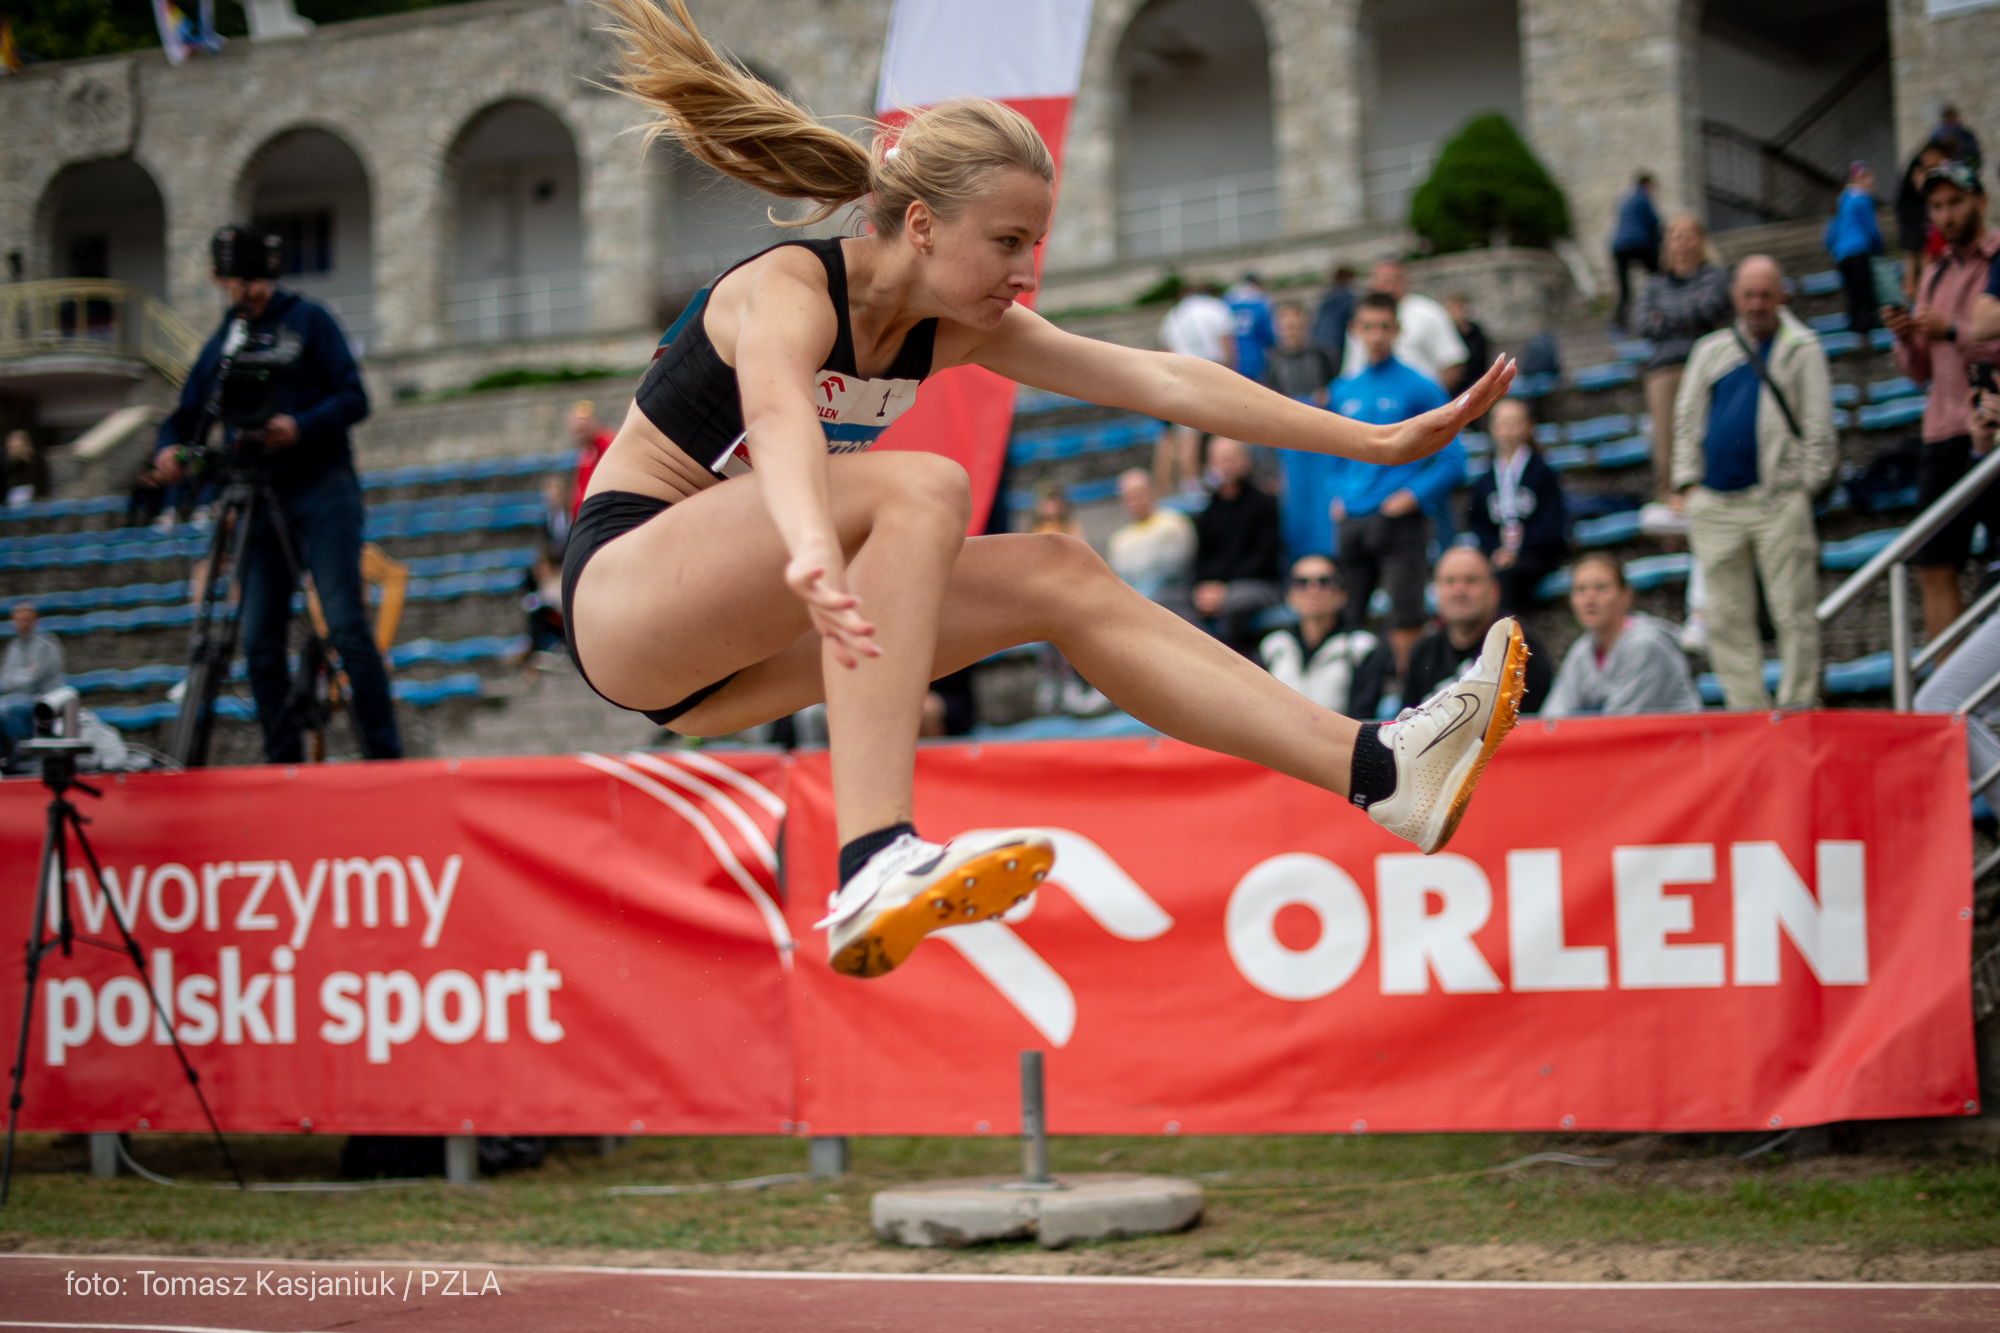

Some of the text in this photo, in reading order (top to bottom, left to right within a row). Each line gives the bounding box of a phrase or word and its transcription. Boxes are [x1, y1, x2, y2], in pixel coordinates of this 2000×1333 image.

[1225, 840, 1869, 1001] ORLEN
[45, 946, 566, 1066] polski sport
